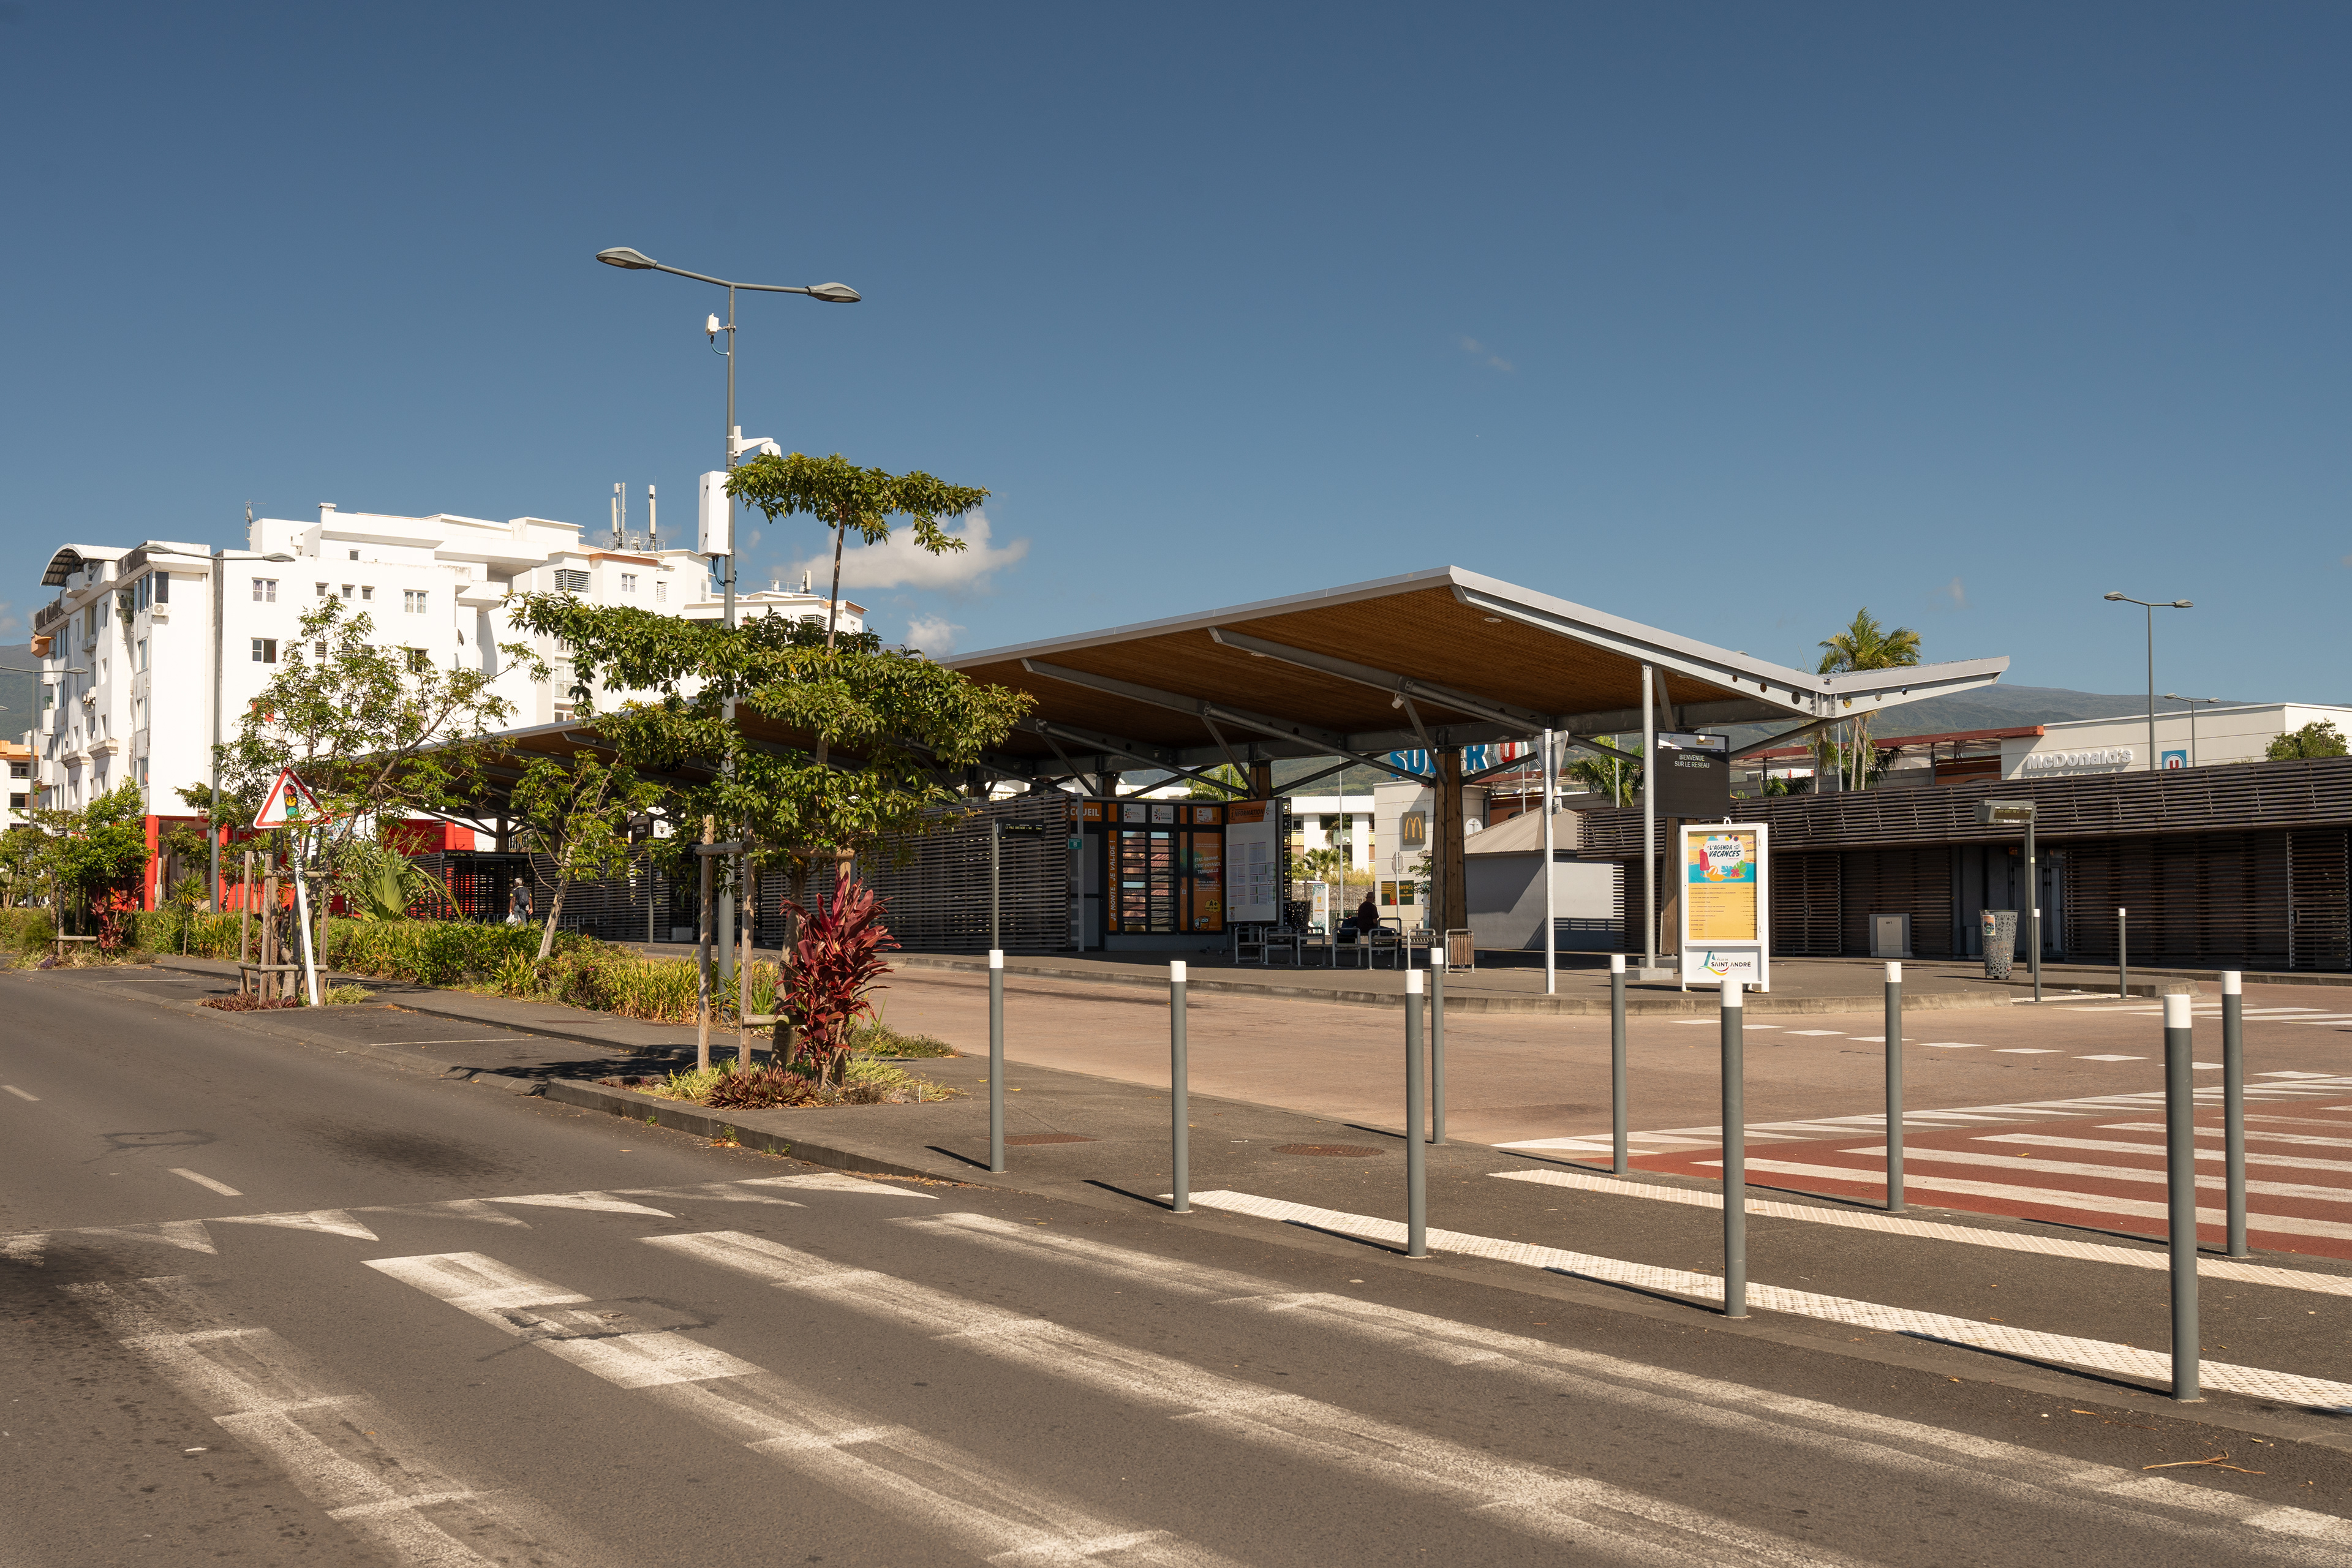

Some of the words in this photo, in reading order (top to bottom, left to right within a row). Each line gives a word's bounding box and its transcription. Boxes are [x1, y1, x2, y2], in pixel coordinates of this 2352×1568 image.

[2027, 749, 2132, 770] McDonald's
[995, 823, 999, 833] 1
[1110, 872, 1115, 881] JE
[1110, 912, 1116, 921] JE
